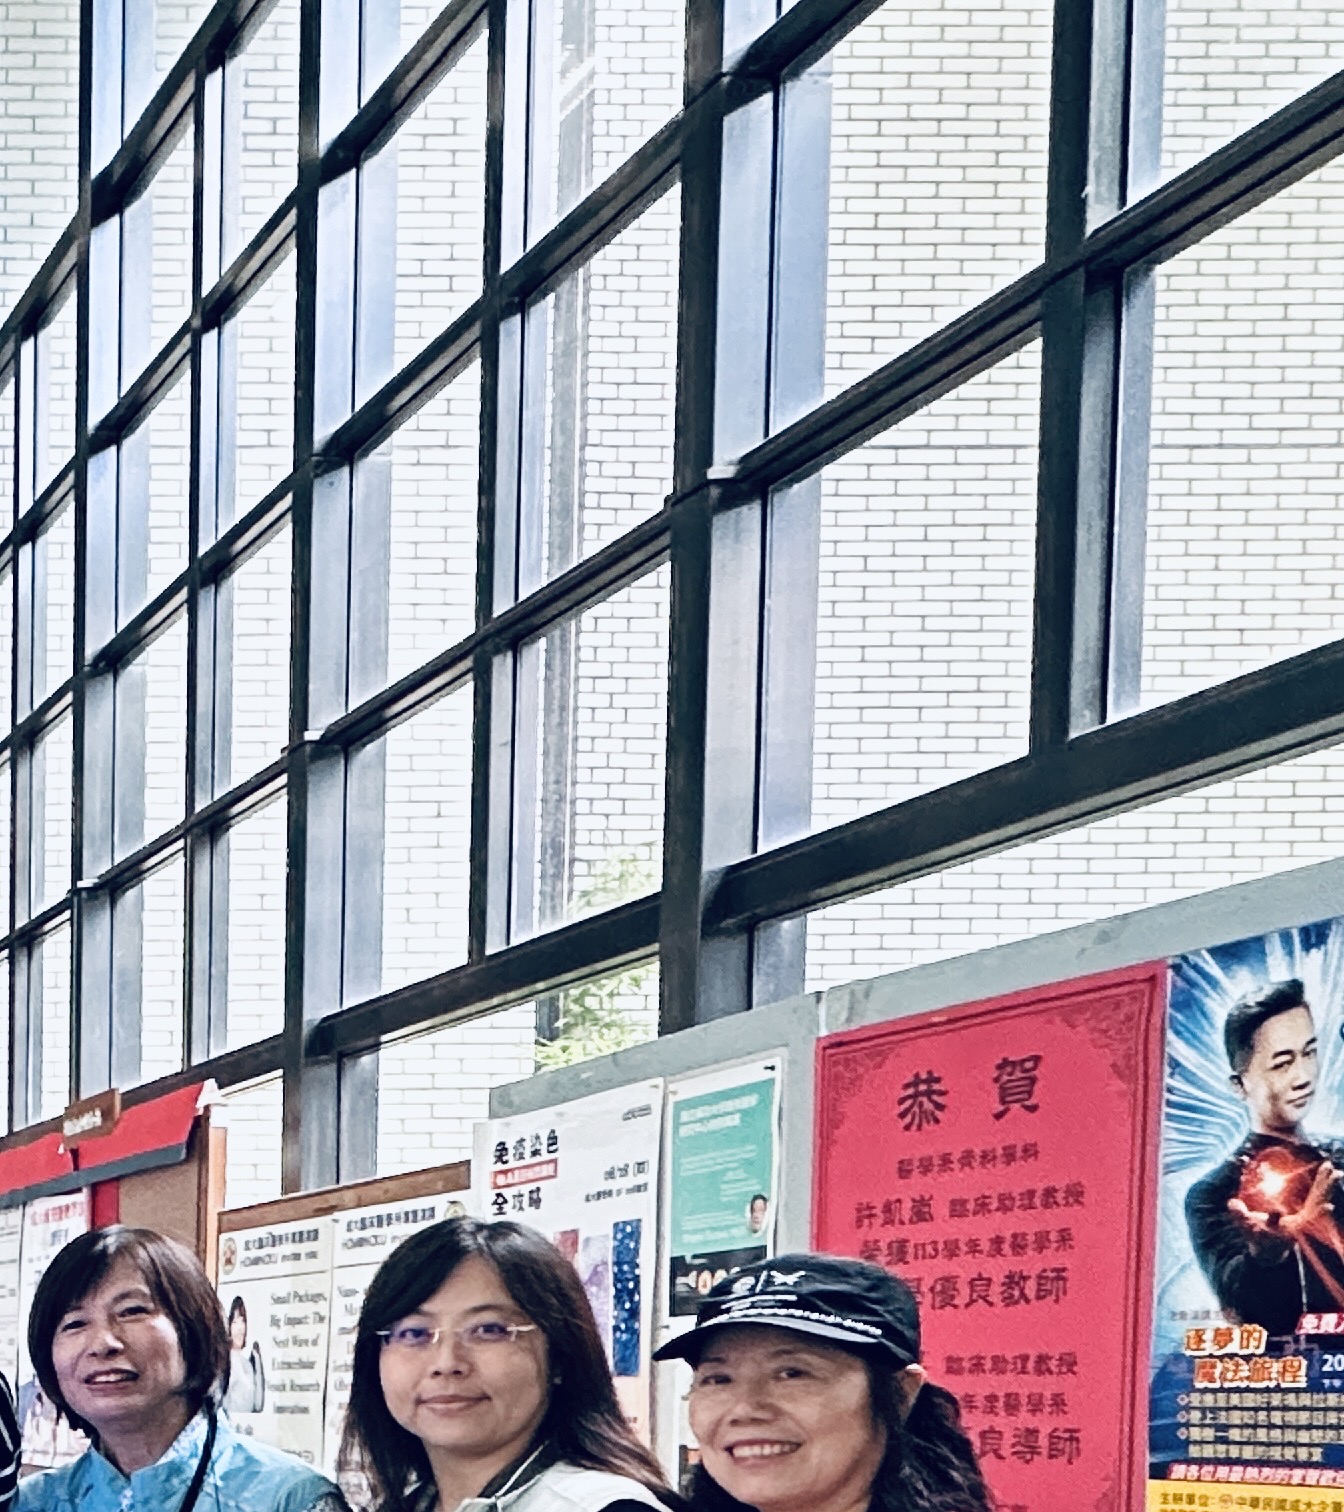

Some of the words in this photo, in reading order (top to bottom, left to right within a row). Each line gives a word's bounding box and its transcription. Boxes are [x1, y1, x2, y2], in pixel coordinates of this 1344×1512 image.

[897, 1055, 1043, 1131] 恭賀
[966, 1425, 1081, 1465] 良導師
